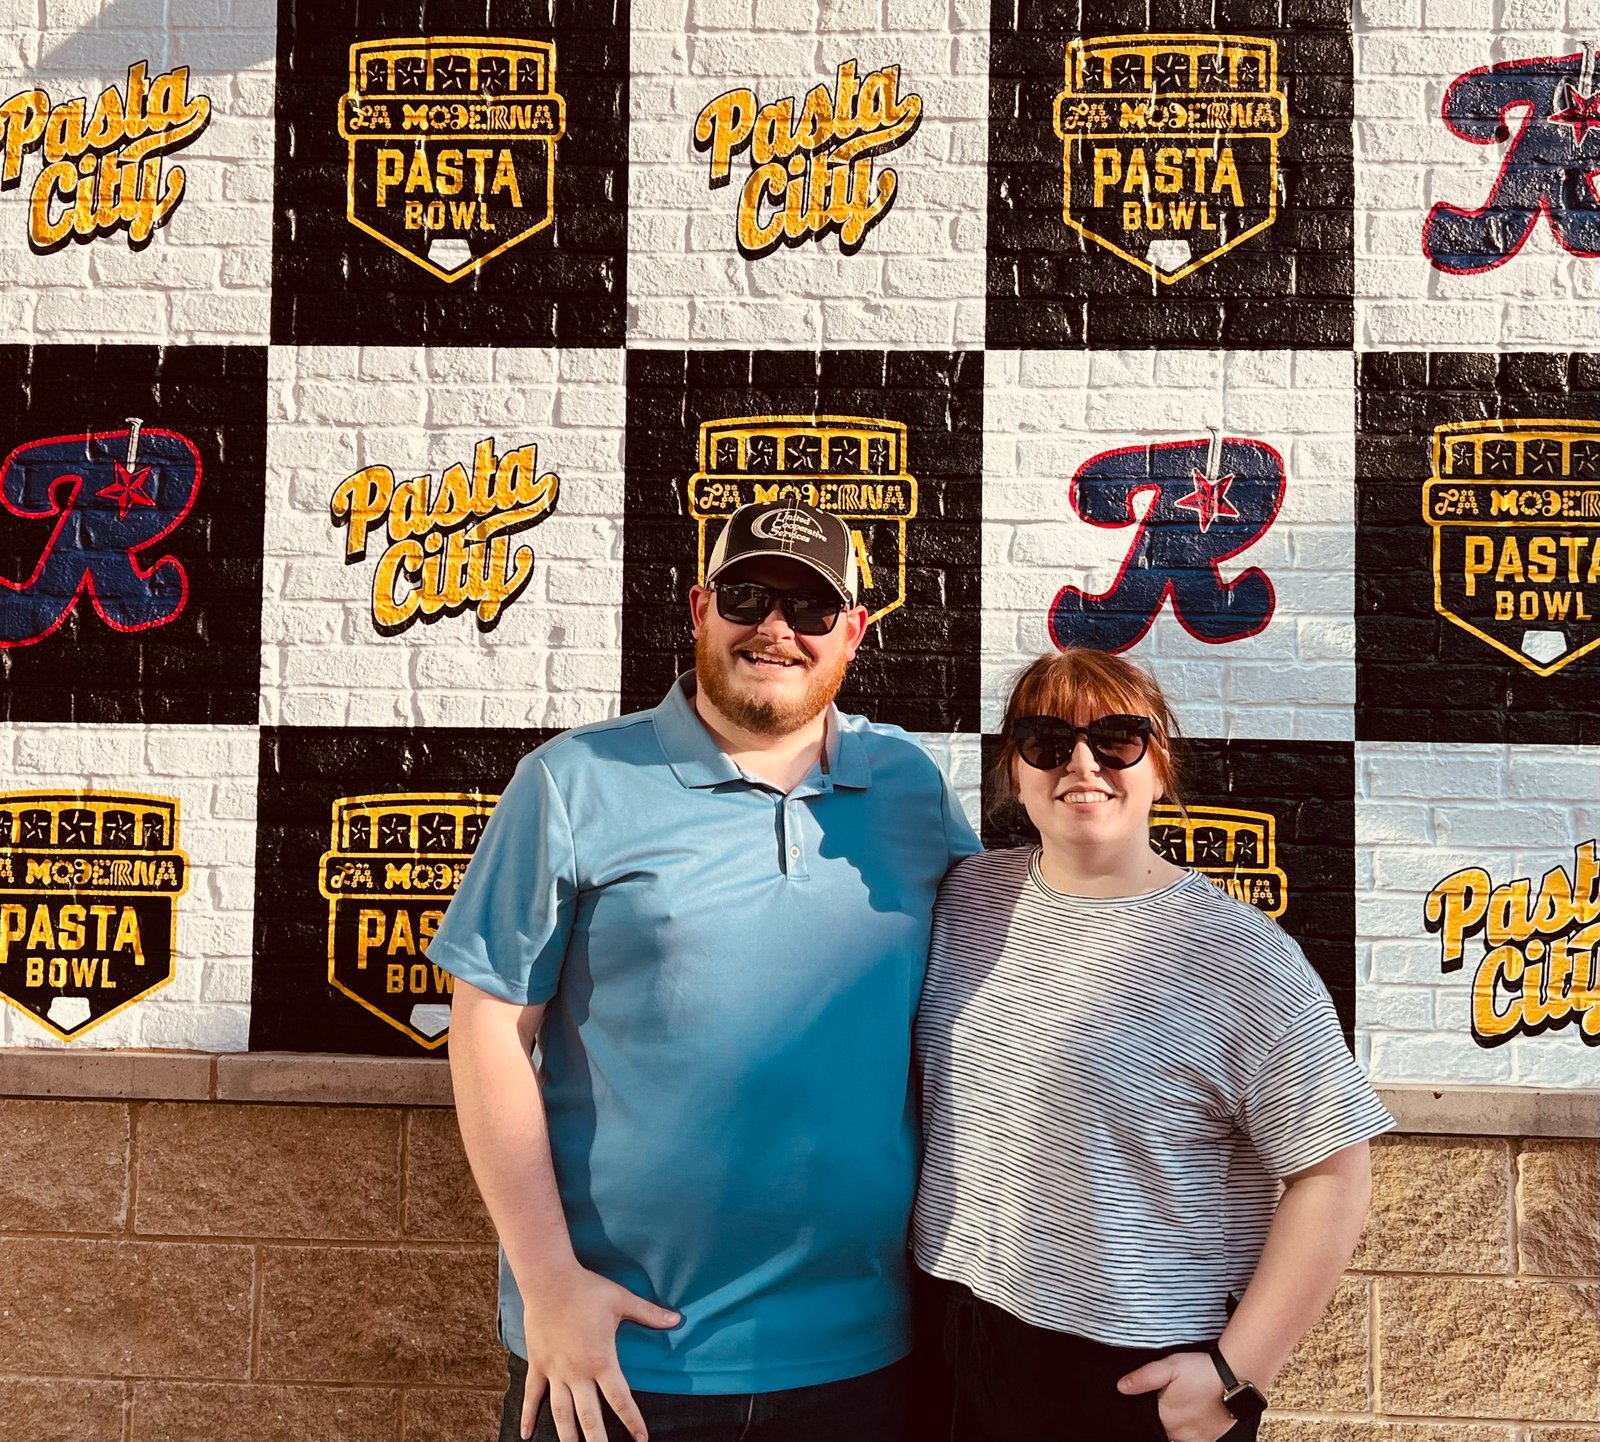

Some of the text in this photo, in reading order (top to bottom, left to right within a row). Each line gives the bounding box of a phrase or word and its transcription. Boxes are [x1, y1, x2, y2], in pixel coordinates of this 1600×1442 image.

[0, 60, 211, 190] Pasta
[350, 104, 554, 130] LA MODERNA
[694, 58, 923, 189] Pasta
[1064, 102, 1277, 130] LA MODERNA
[376, 148, 524, 208] PASTA
[1093, 147, 1245, 208] PASTA
[29, 152, 186, 256] City
[404, 200, 496, 231] BOWL
[736, 152, 898, 261] City
[1122, 200, 1218, 231] BOWL
[331, 436, 561, 566] Pasta
[699, 483, 742, 510] LA
[1434, 488, 1600, 517] LA MODER
[771, 518, 828, 543] Cooperative
[776, 511, 811, 526] United
[767, 526, 811, 543] Services
[371, 530, 536, 638] City
[1494, 590, 1593, 621] BOWL
[0, 858, 178, 887] A MODERNA
[330, 862, 471, 890] LA MODE
[1424, 838, 1600, 974] Past
[0, 903, 146, 967] PASTA
[357, 908, 445, 970] PAS
[25, 956, 117, 989] BOWL
[386, 963, 456, 994] BOW
